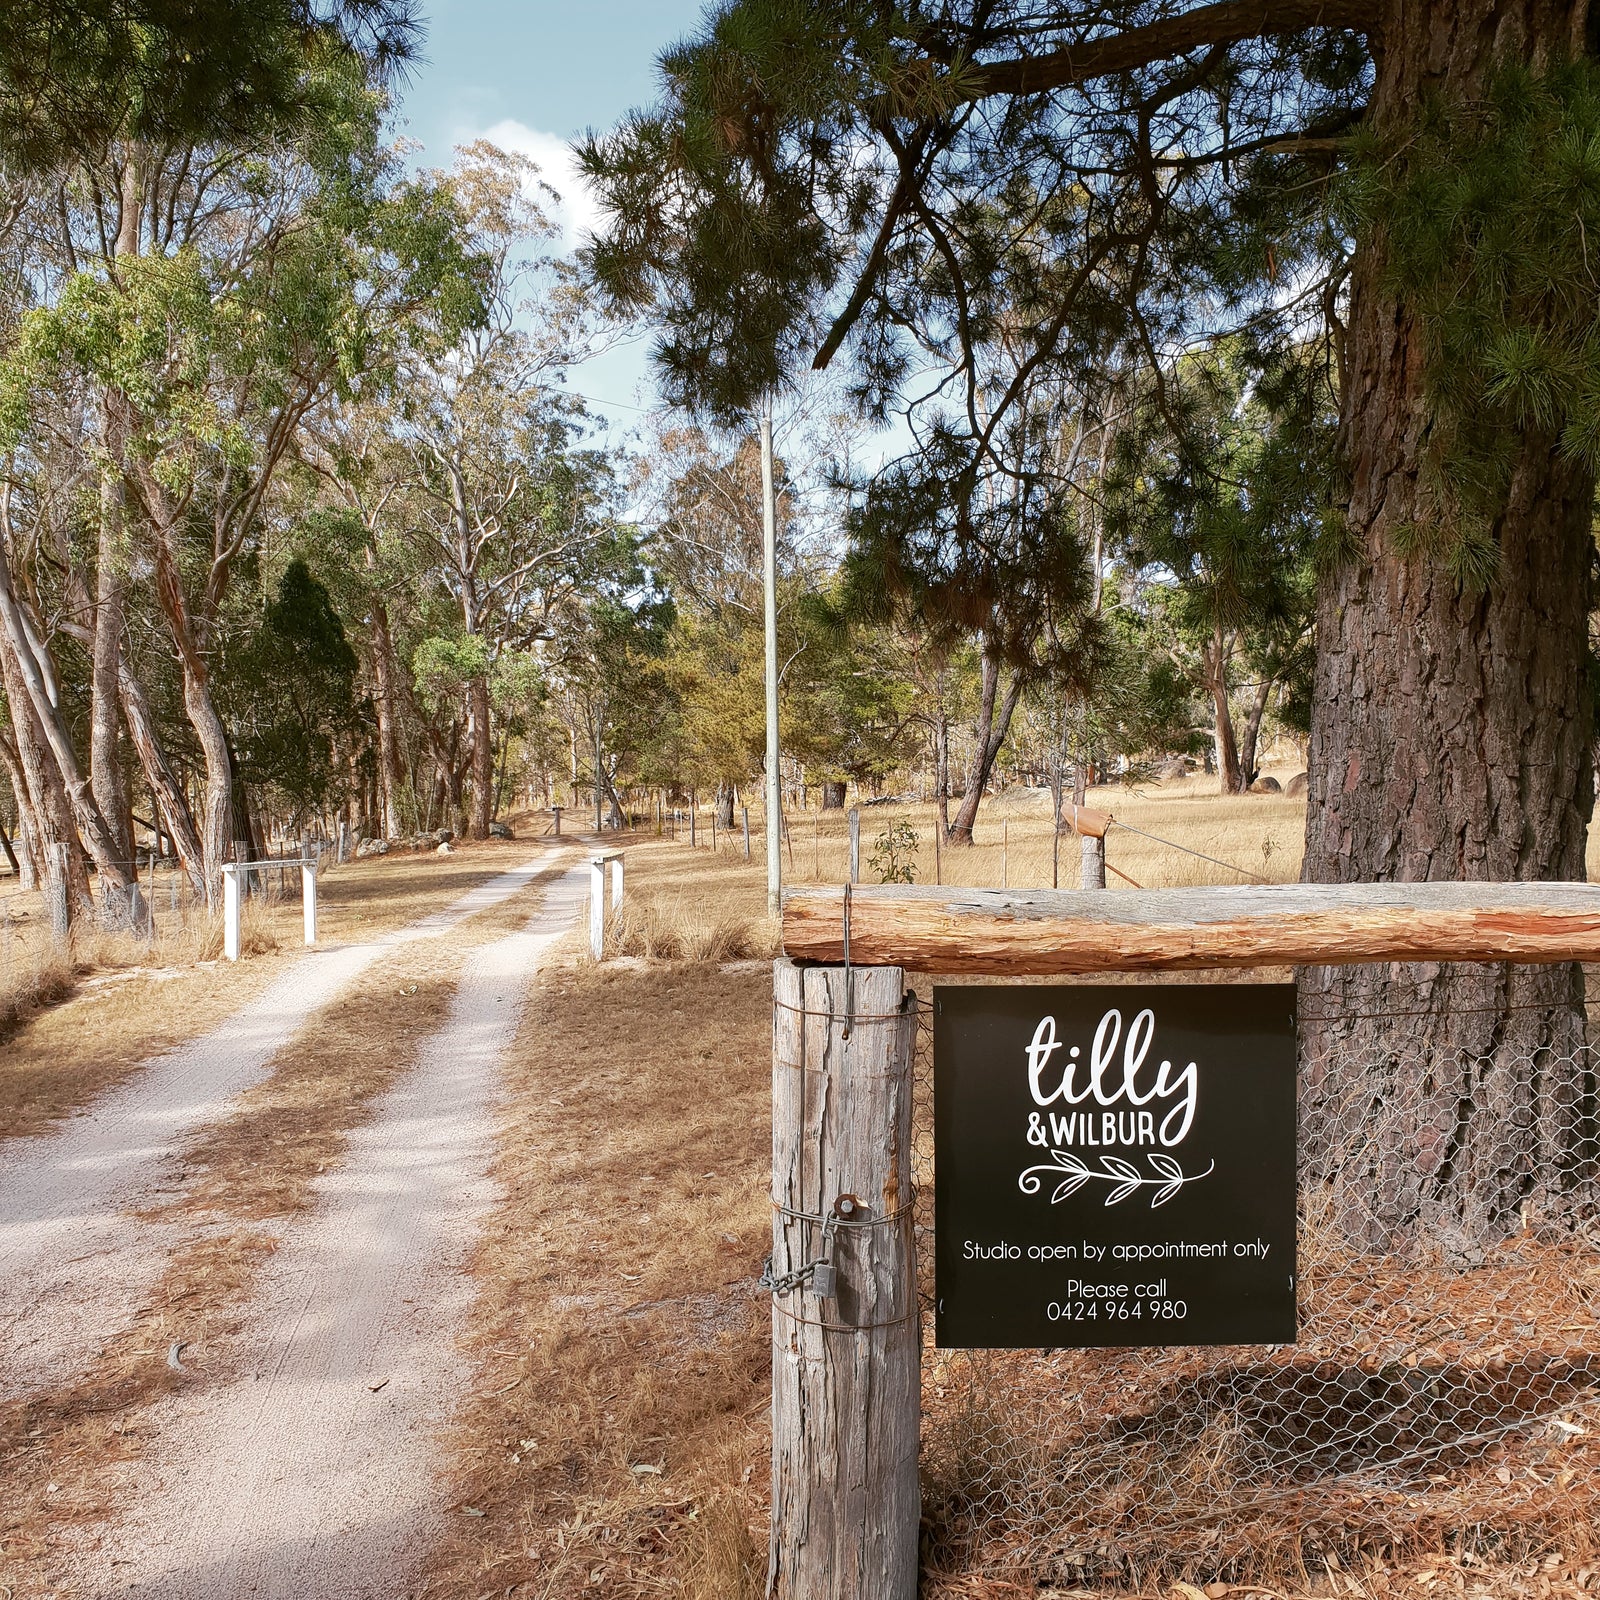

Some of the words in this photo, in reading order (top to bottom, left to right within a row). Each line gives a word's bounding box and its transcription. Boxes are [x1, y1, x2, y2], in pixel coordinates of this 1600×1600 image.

[1025, 1008, 1198, 1147] tilly
[962, 1240, 1022, 1260] Studio
[1027, 1245, 1077, 1263] open
[1083, 1239, 1107, 1263] by
[1112, 1240, 1228, 1262] appointment
[1233, 1237, 1271, 1260] only
[1067, 1279, 1129, 1298] Please
[1134, 1278, 1167, 1298] call
[1047, 1301, 1098, 1321] 0424
[1105, 1300, 1142, 1320] 964
[1149, 1300, 1187, 1320] 980
